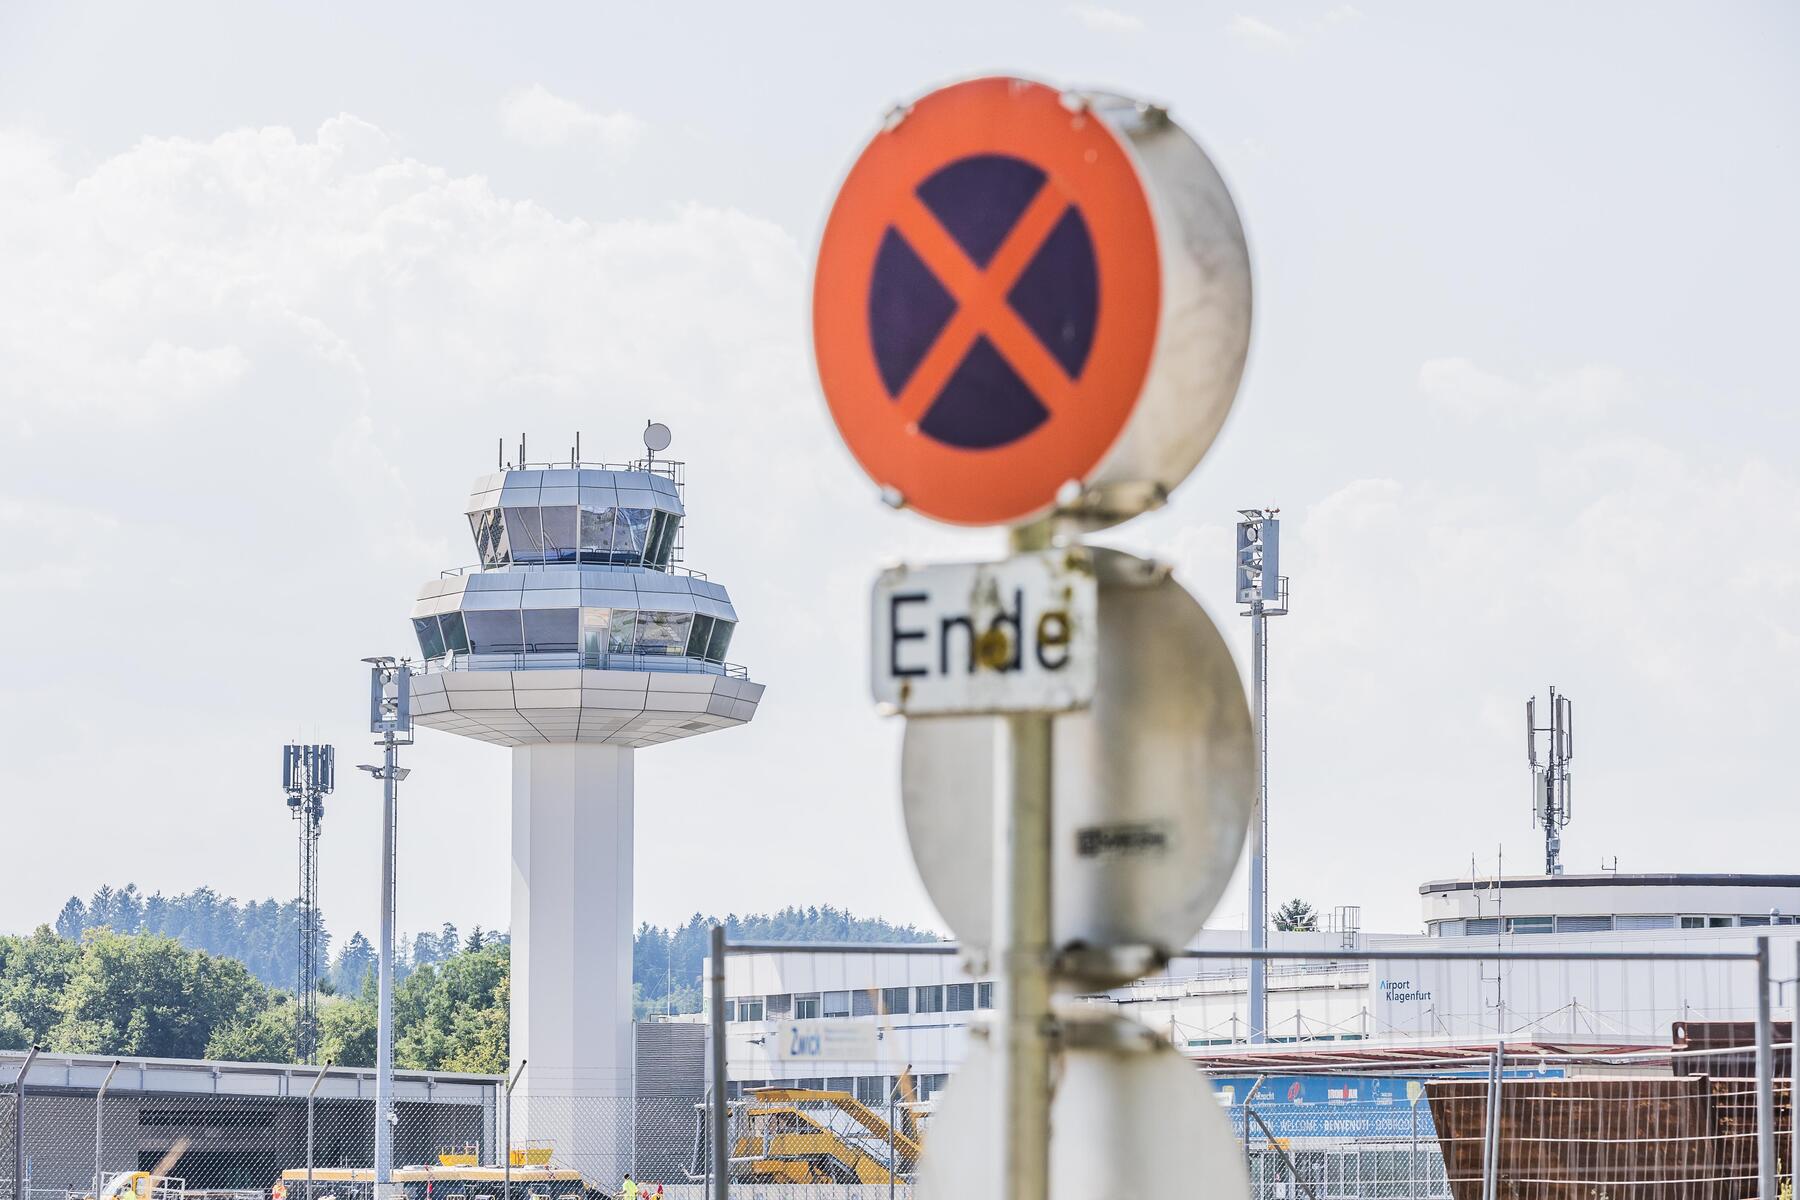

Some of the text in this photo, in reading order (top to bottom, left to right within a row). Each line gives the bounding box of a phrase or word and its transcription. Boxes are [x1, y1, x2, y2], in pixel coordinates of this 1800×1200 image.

[891, 588, 1071, 677] Ende
[1380, 980, 1410, 990] Airport
[1386, 990, 1431, 1003] Klagenfurt
